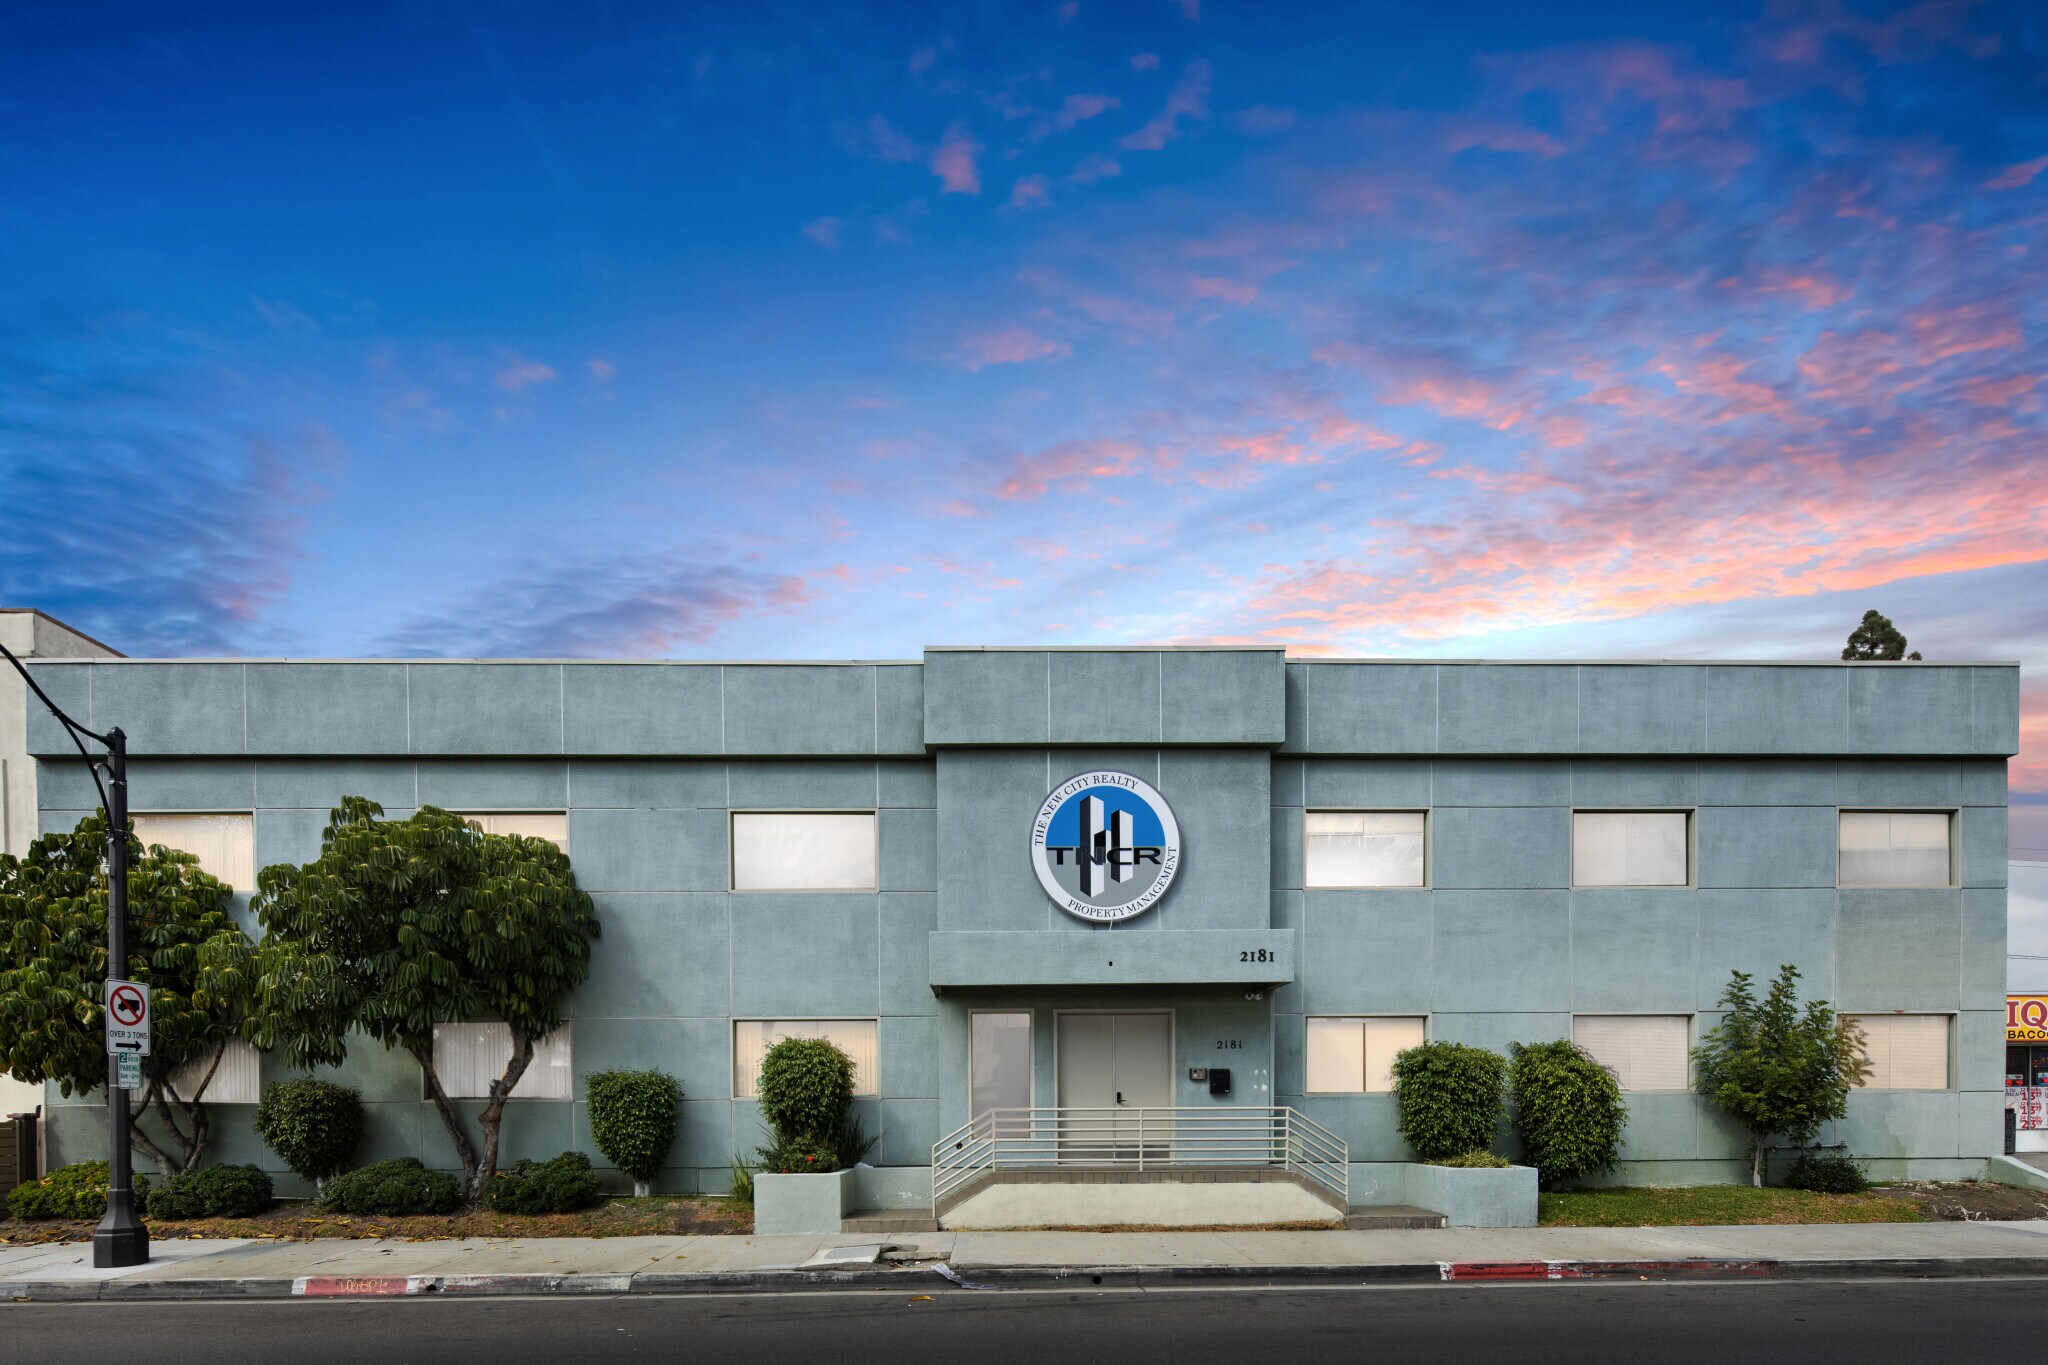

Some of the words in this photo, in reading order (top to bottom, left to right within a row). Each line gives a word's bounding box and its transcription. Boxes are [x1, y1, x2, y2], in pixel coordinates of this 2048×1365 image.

[1034, 820, 1047, 846] THE
[1042, 792, 1063, 819] NEW
[1064, 776, 1089, 795] CITY
[1092, 774, 1139, 790] REALTY
[1046, 847, 1162, 866] TNCR
[1067, 899, 1126, 918] PROPERTY
[1126, 846, 1177, 914] MANAGEMENT
[1240, 949, 1275, 962] 2181
[109, 1030, 126, 1038] OVER
[126, 1031, 132, 1039] 3
[132, 1031, 148, 1040] TONS
[2007, 1030, 2048, 1039] BACO
[1216, 1039, 1242, 1050] 2181
[120, 1053, 127, 1062] 2
[120, 1064, 139, 1072] PARKING
